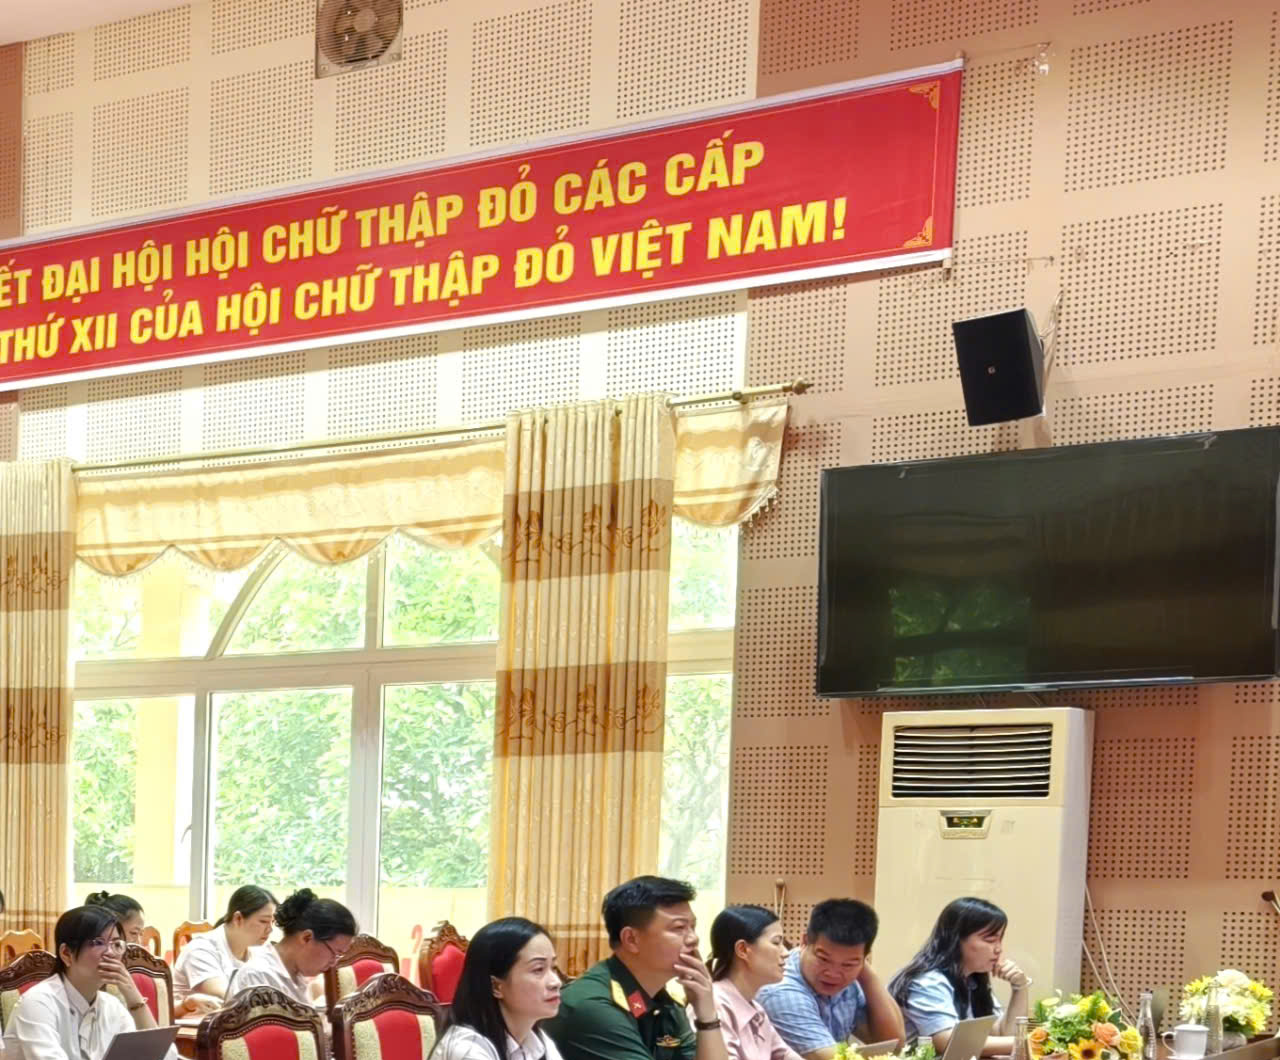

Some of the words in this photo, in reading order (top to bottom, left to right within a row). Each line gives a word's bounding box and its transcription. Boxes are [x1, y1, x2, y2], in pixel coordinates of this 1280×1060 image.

[41, 257, 100, 304] ĐẠI
[112, 240, 172, 289] HỘI
[186, 226, 248, 275] HỘI
[262, 202, 347, 262] CHỮ
[355, 191, 464, 249] THẬP
[477, 164, 537, 228] ĐỎ
[554, 160, 647, 215] CÁC
[665, 129, 764, 196] CẤP
[70, 312, 118, 353] XII
[129, 290, 204, 345] CỦA
[216, 283, 281, 335] HỘI
[294, 263, 382, 321] CHỮ
[389, 250, 500, 307] THẬP
[514, 225, 575, 289] ĐỎ
[591, 219, 692, 279] VIỆT
[707, 197, 847, 260] NAM!
